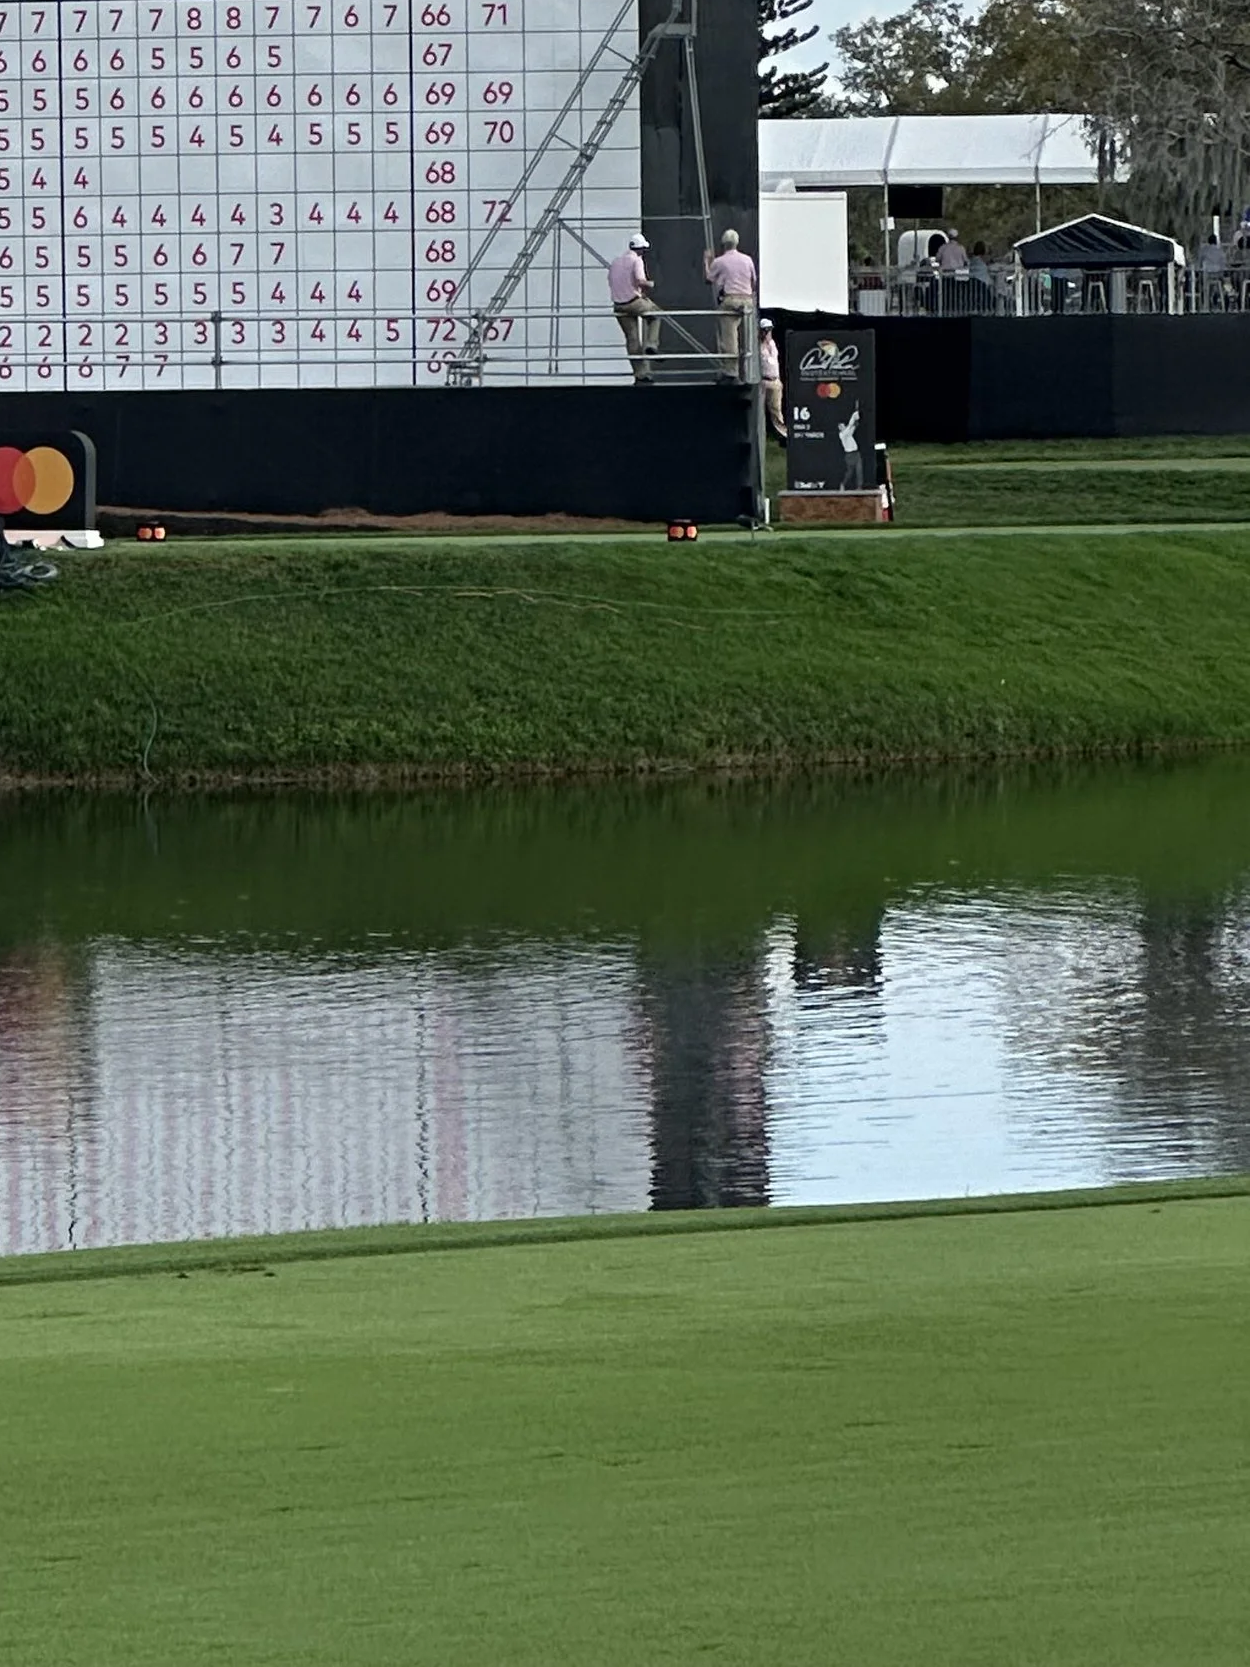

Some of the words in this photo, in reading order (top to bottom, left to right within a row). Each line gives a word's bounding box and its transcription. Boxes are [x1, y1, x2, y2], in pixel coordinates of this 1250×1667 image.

[32, 11, 44, 33] 7
[74, 11, 87, 32] 7
[109, 10, 122, 31] 7
[149, 9, 162, 31] 7
[187, 8, 201, 30] 8
[227, 7, 241, 29] 8
[266, 7, 279, 29] 7
[307, 6, 321, 28] 7
[345, 5, 358, 27] 6
[384, 5, 397, 27] 7
[422, 4, 450, 26] 66
[482, 4, 506, 25] 71
[423, 43, 452, 65] 67
[34, 89, 46, 111] 5
[76, 88, 89, 110] 5
[110, 88, 124, 110] 6
[151, 86, 165, 109] 6
[189, 86, 203, 108] 6
[229, 86, 242, 107] 6
[267, 85, 281, 107] 6
[308, 84, 322, 106] 6
[346, 84, 360, 105] 6
[384, 83, 397, 105] 6
[426, 82, 455, 105] 69
[483, 82, 512, 104] 69
[426, 122, 454, 144] 69
[485, 121, 513, 144] 70
[426, 161, 455, 183] 68
[32, 207, 45, 229] 5
[74, 206, 87, 228] 6
[112, 206, 127, 227] 4
[152, 205, 166, 226] 4
[192, 204, 205, 226] 4
[231, 204, 245, 225] 4
[270, 203, 283, 225] 3
[309, 203, 323, 224] 4
[347, 202, 361, 223] 4
[384, 202, 398, 223] 4
[426, 201, 455, 223] 68
[426, 240, 455, 262] 68
[427, 279, 457, 302] 69
[426, 318, 456, 342] 72
[794, 406, 810, 420] 16
